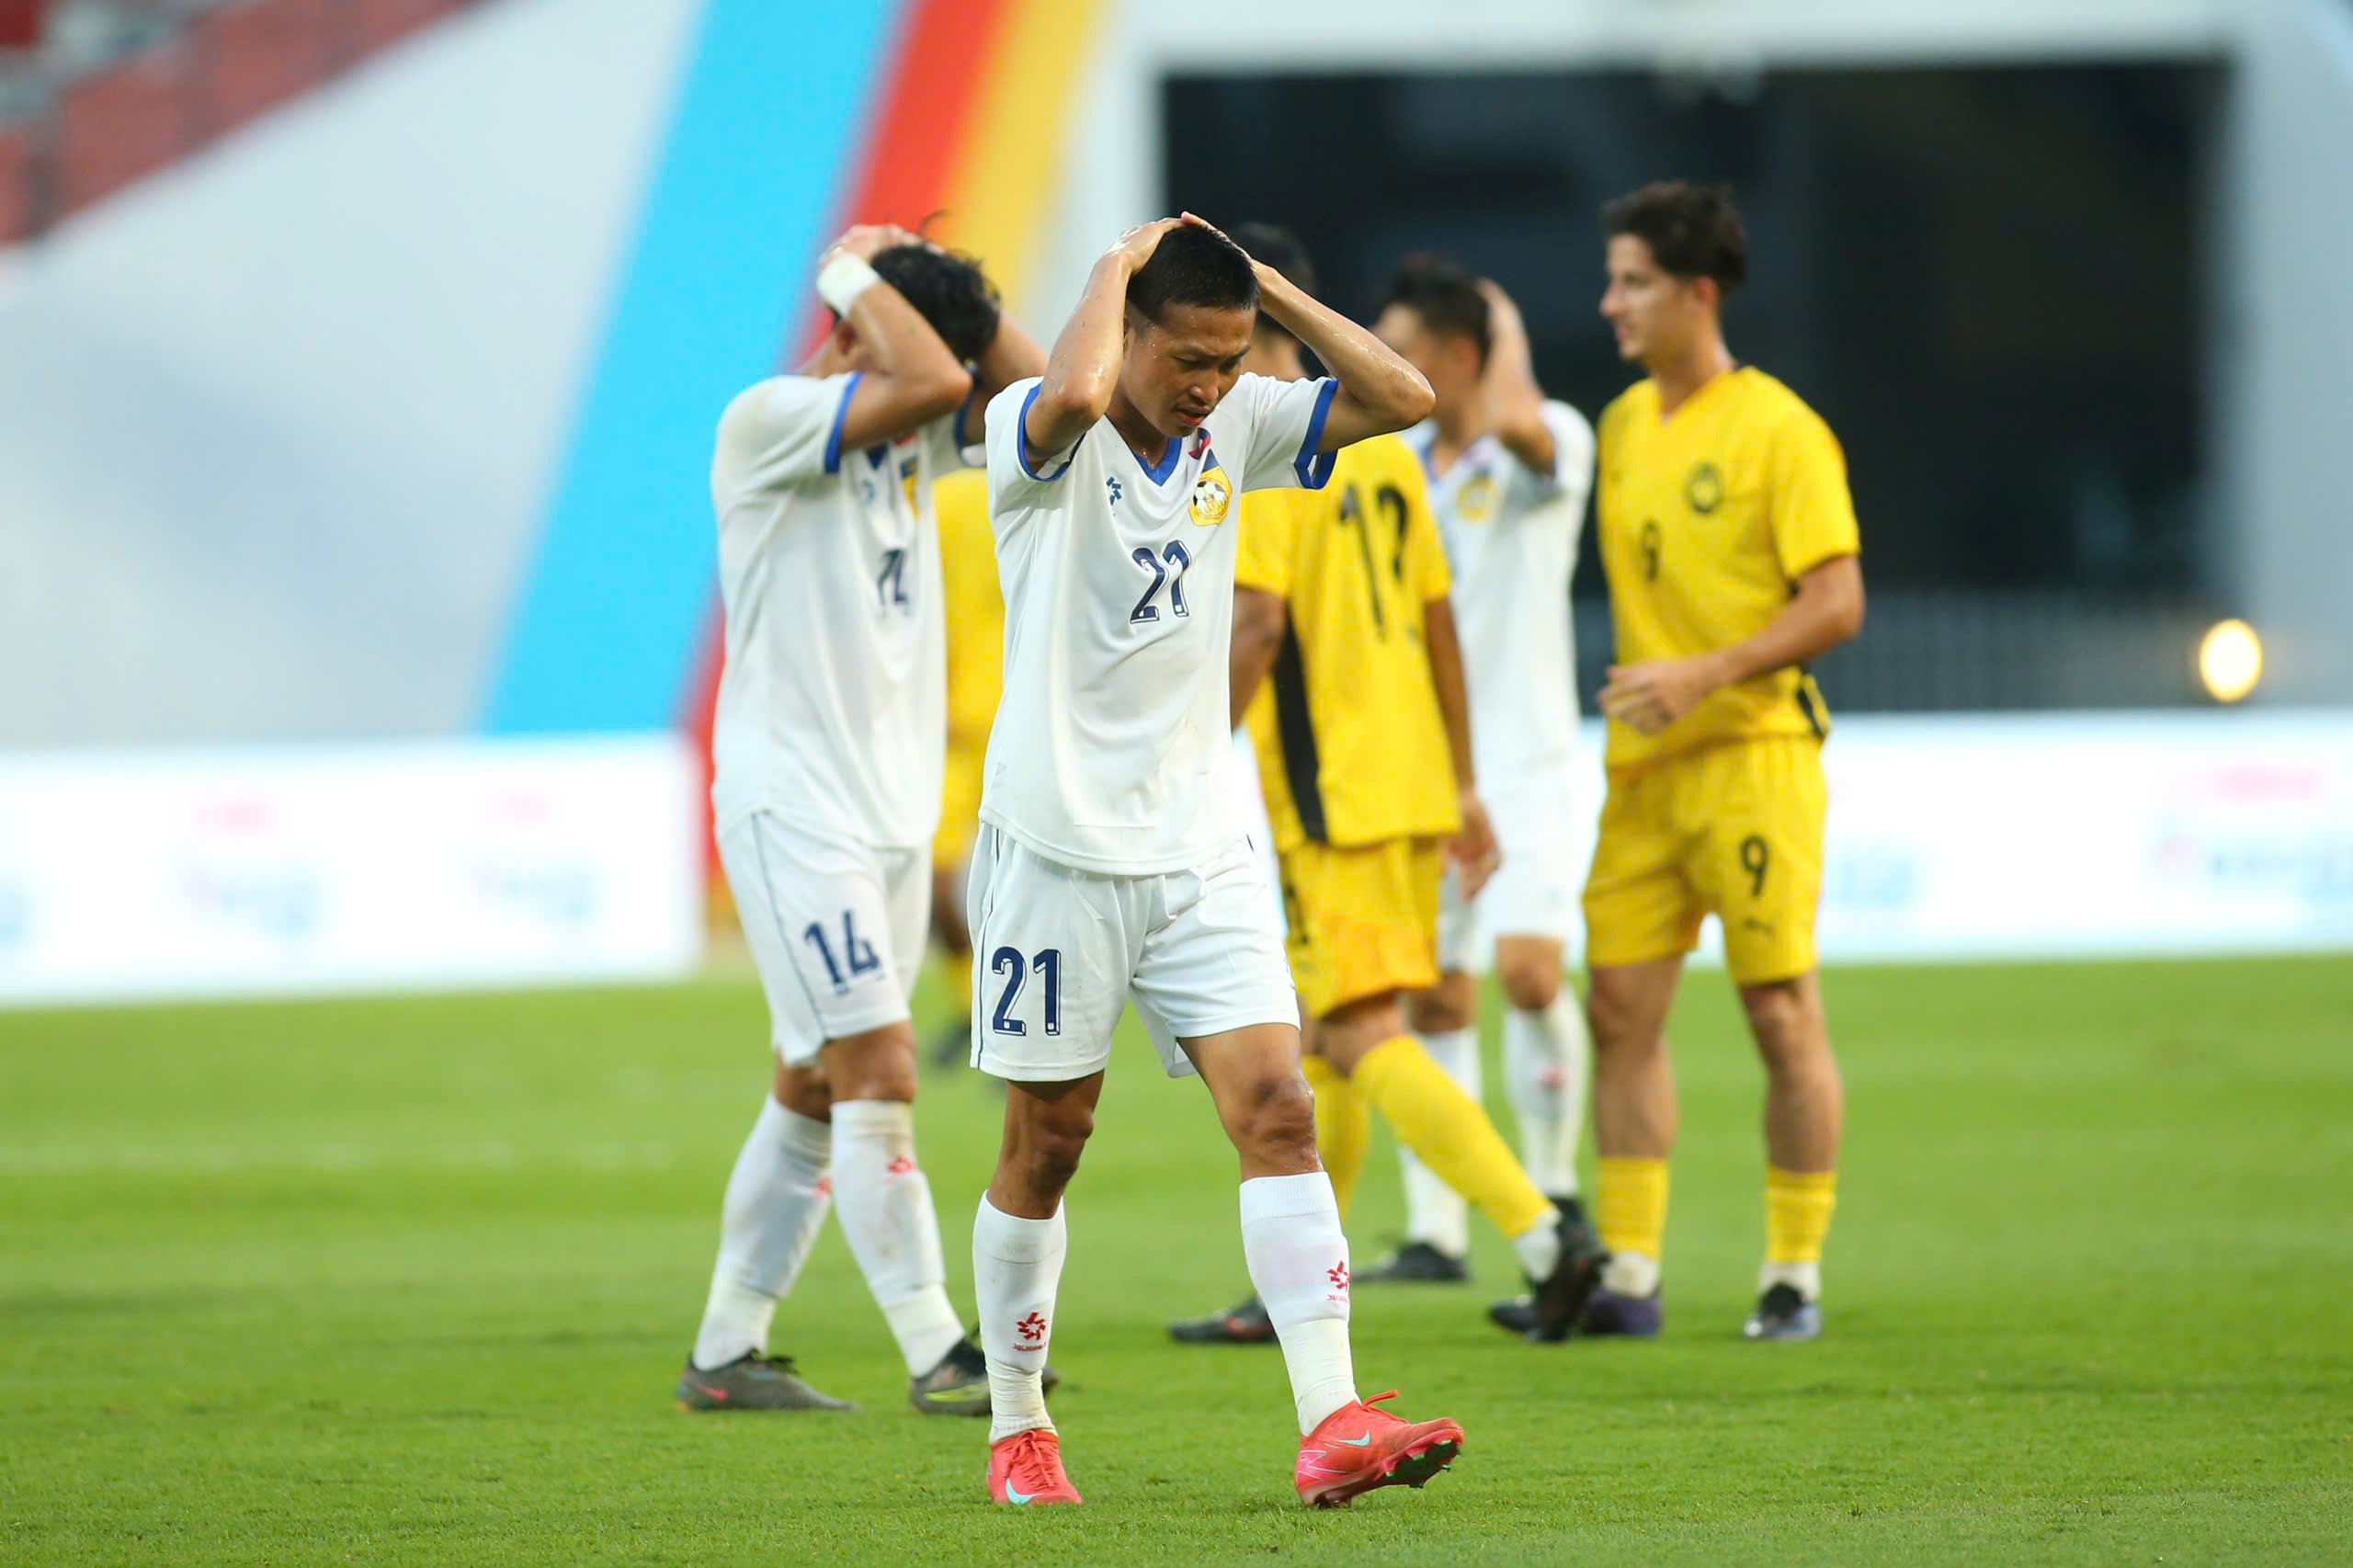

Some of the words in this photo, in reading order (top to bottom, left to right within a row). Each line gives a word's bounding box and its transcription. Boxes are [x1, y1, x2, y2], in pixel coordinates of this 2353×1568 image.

[1130, 540, 1192, 624] 21
[1740, 835, 1769, 897] 9
[805, 910, 882, 995] 14
[992, 947, 1061, 1036] 21
